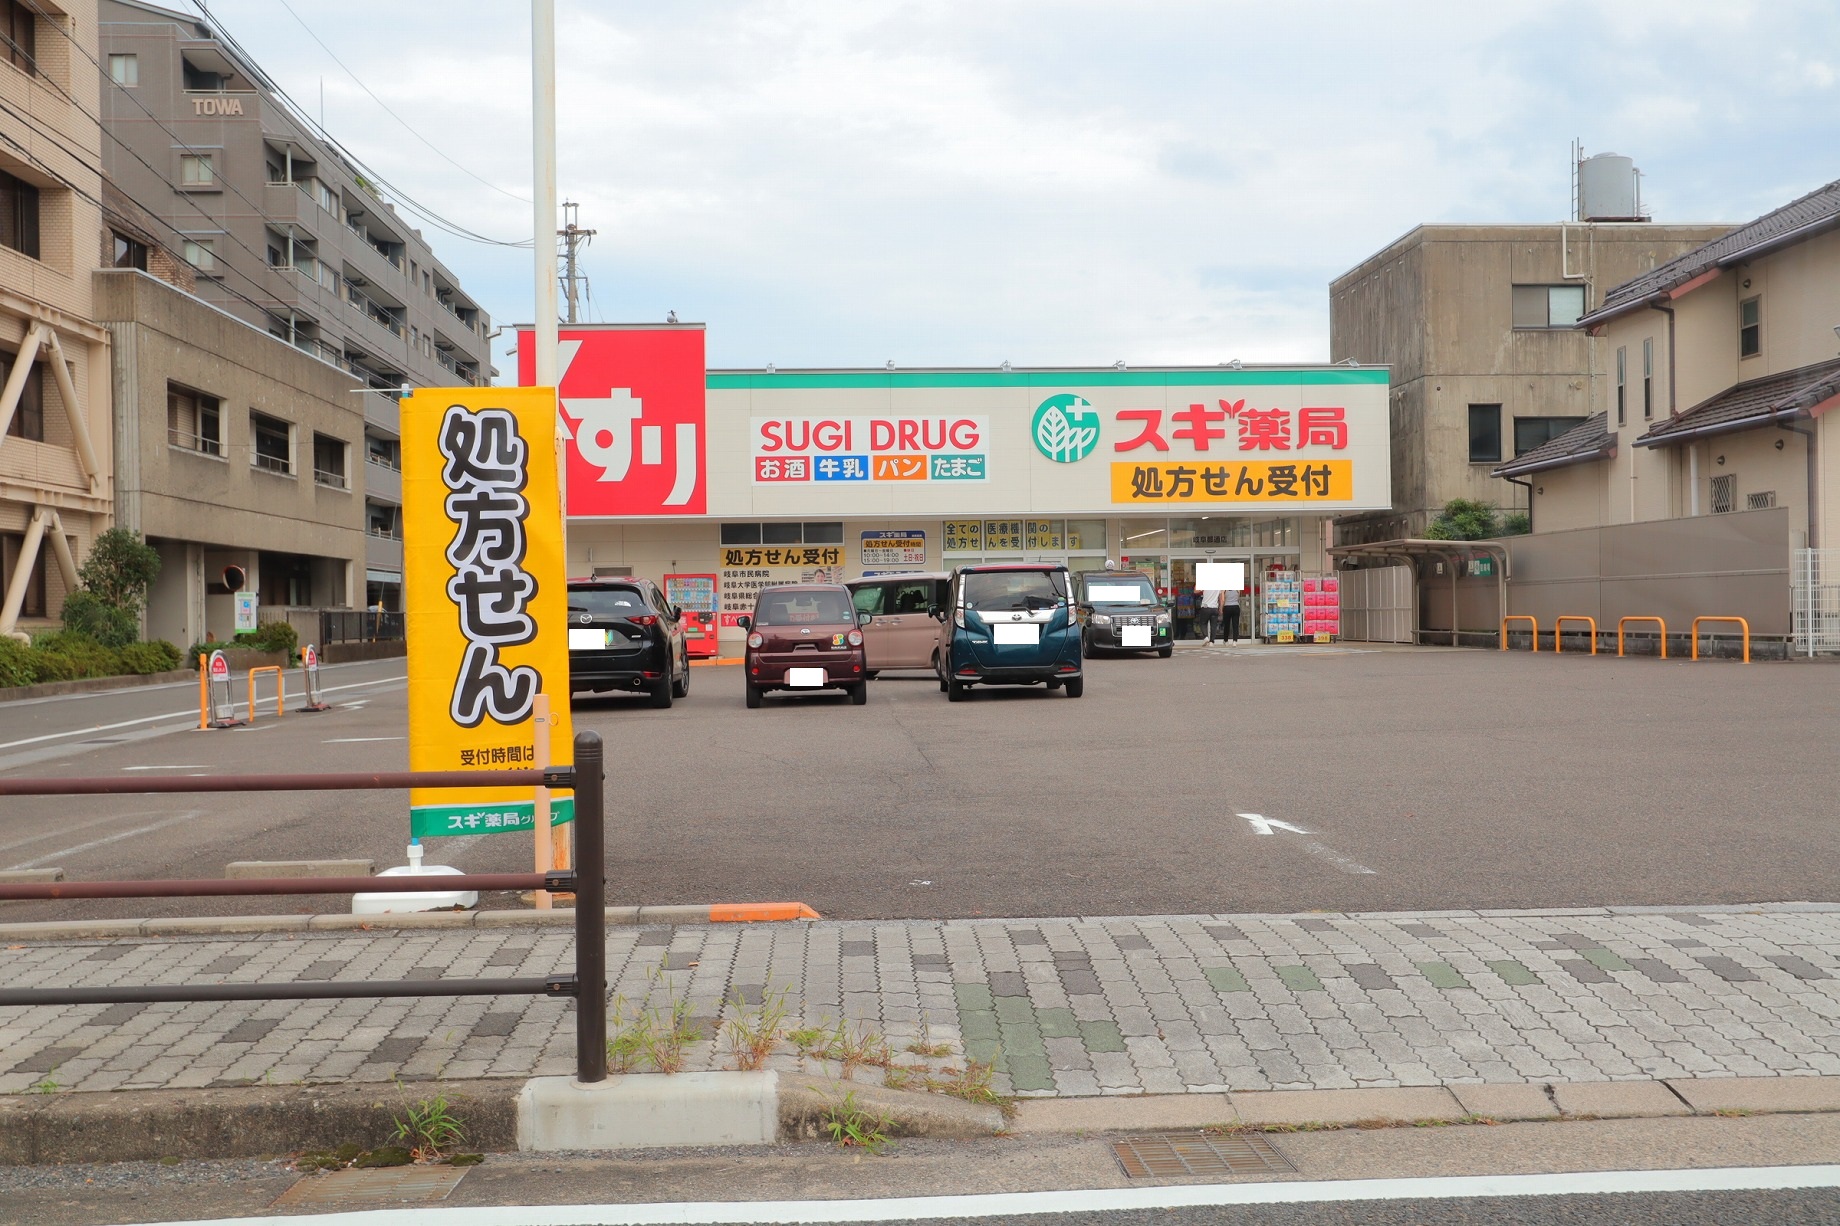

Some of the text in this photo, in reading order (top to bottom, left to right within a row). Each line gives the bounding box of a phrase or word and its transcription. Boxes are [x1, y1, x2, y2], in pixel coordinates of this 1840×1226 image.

[192, 99, 243, 115] TOWA
[760, 419, 980, 451] SUGI DRUG
[1114, 399, 1348, 452] スギ薬局
[760, 457, 982, 479] お酒 牛乳 パン たまご
[1131, 464, 1332, 498] 処方せん受付
[438, 404, 542, 729] 処方せん
[725, 548, 840, 566] 処方せん受付
[723, 570, 770, 578] 岐阜市民病院
